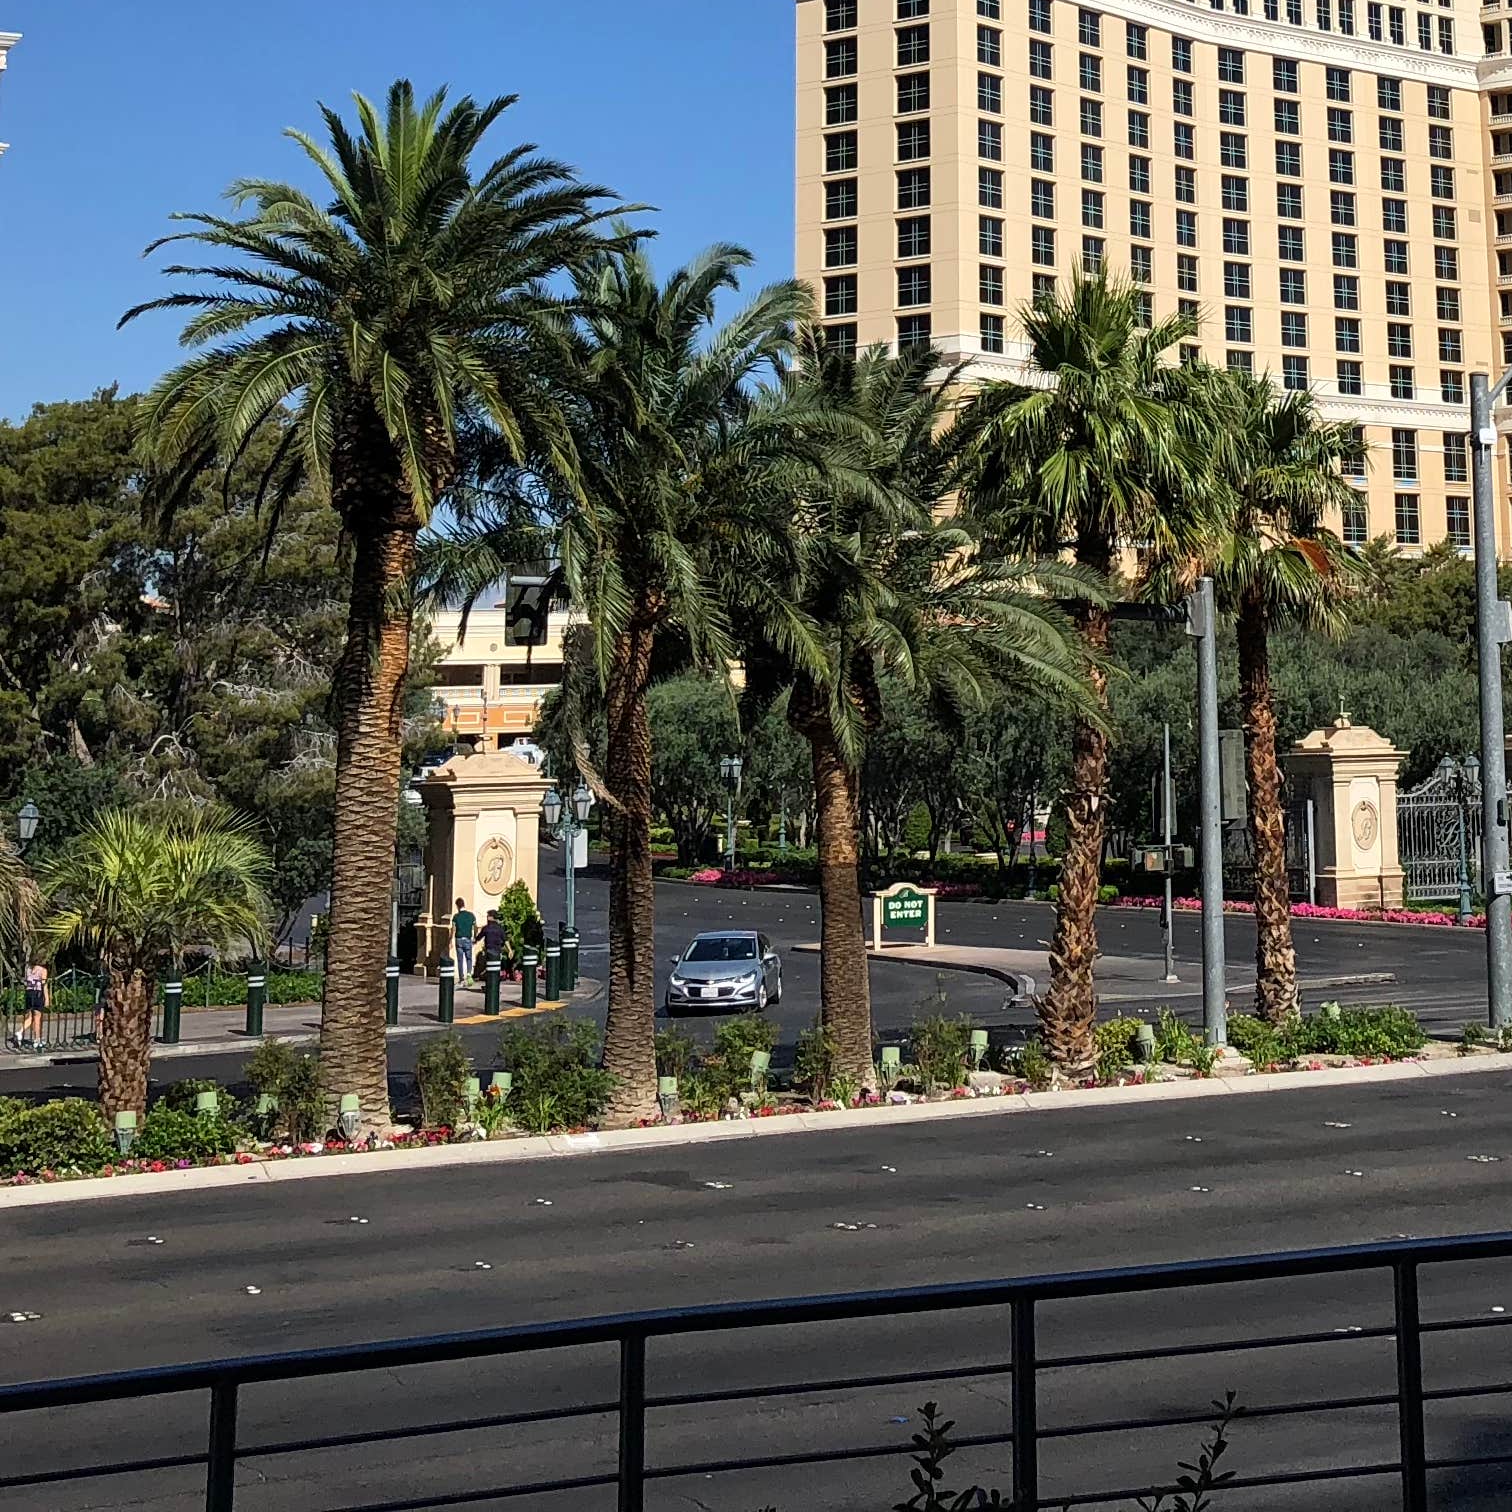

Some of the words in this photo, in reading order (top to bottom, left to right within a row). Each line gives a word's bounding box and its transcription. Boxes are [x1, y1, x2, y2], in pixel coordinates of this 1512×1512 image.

[888, 901, 902, 910] DO
[904, 899, 924, 909] NOT
[890, 909, 922, 920] ENTER
